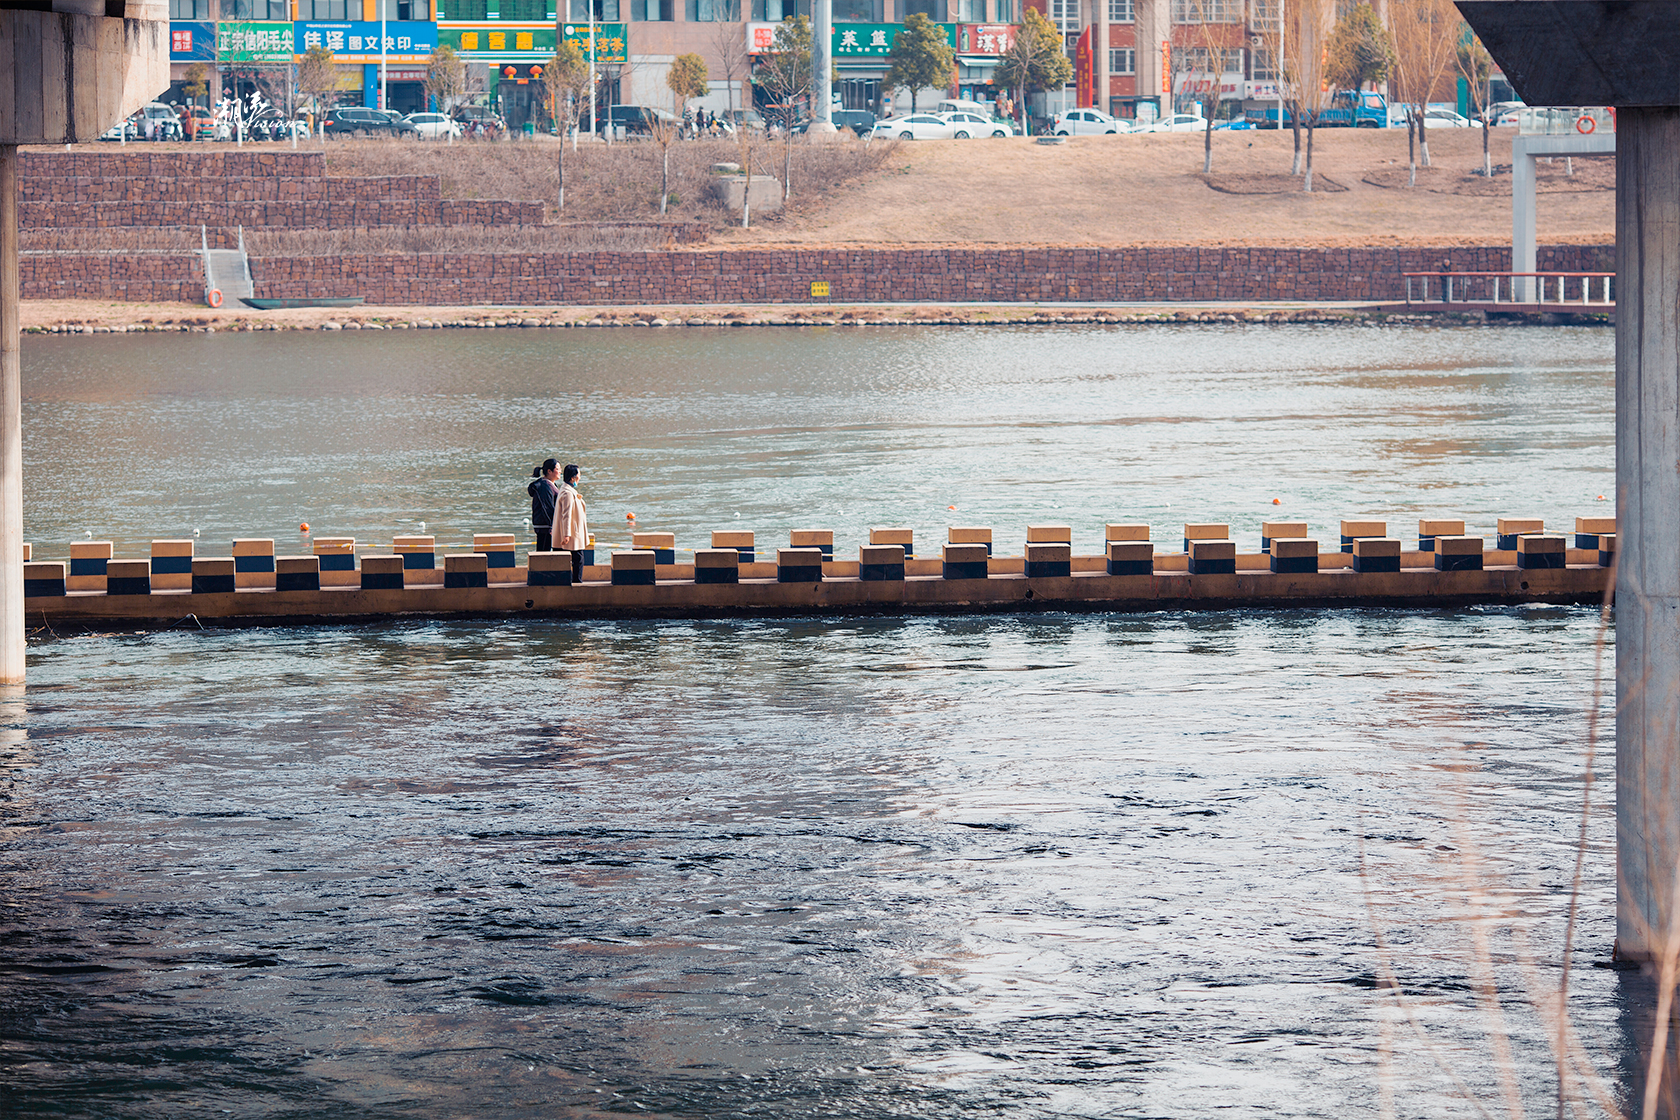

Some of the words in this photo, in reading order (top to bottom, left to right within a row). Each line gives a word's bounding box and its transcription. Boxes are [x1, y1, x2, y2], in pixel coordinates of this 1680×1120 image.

[218, 29, 294, 52] 正宗信阳毛尖
